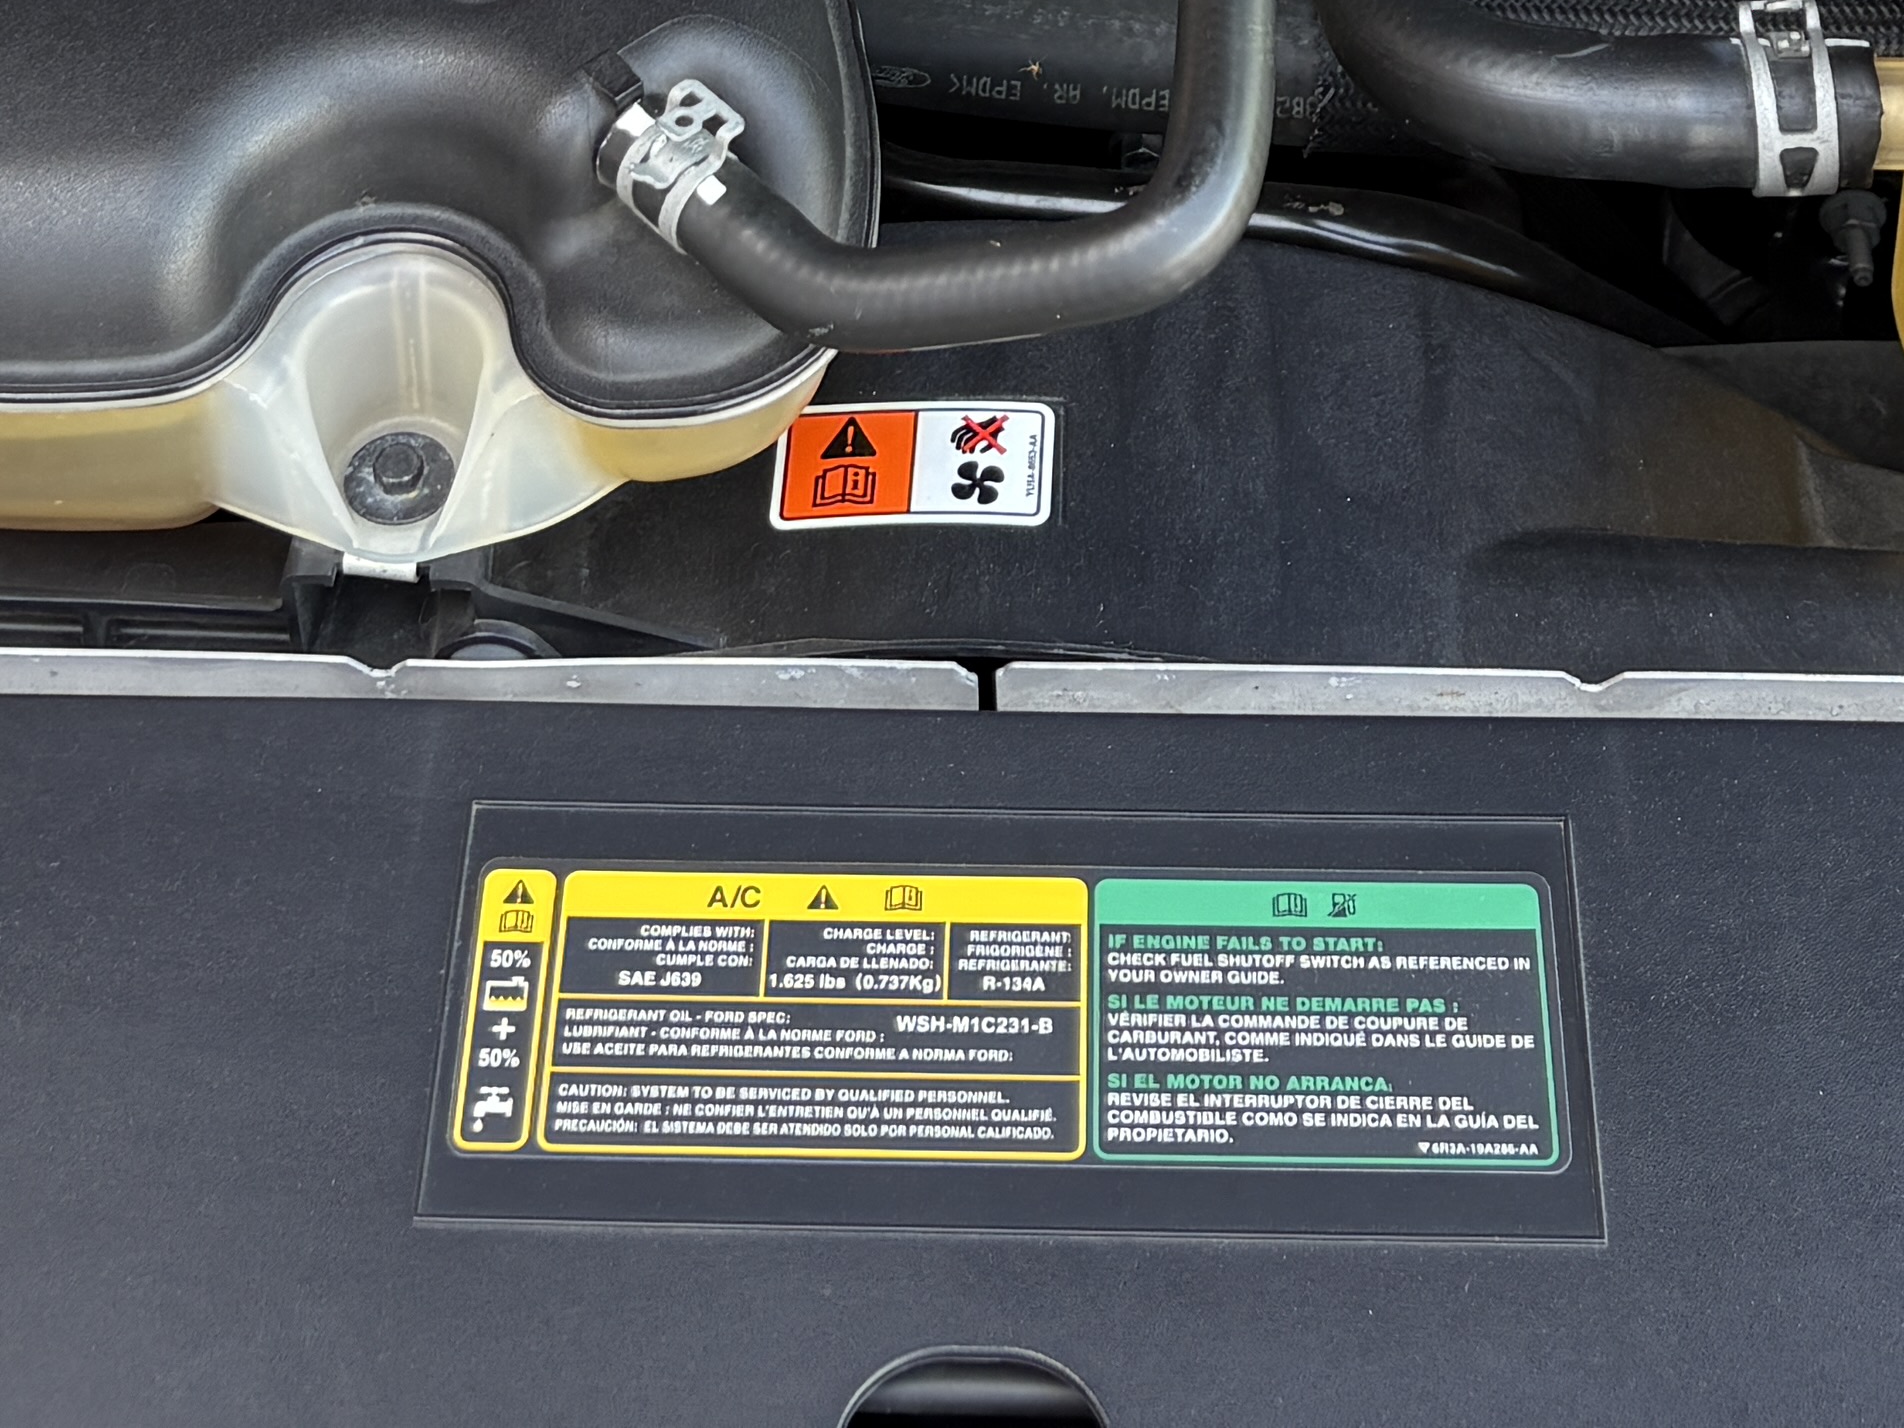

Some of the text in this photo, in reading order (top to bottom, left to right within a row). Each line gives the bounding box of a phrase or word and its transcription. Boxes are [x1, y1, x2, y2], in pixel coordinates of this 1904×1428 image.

[707, 885, 761, 909] A/C
[1108, 934, 1384, 952] IF ENGINE FAILS TO START:
[490, 949, 531, 969] 50%
[1107, 952, 1532, 970] CHECK FUEL SHUTOFF SWITCH AS REFERENCED IN
[618, 970, 702, 987] SAE J639
[769, 973, 942, 992] 1.625 lbs (0.737Kg)
[982, 976, 1046, 992] R-134A
[1107, 969, 1284, 985] YOUR OWNER GUIDE.
[1107, 994, 1446, 1013] SI LE MOTEUR NE DEMARRE PAS
[895, 1015, 1053, 1034] WSH-M1C231-B
[1107, 1010, 1468, 1031] VÉRIFIER LA COMMANDE DE COUPURE DE
[1107, 1030, 1535, 1049] CARBURANT, COMME INDIQUÉ DANS LE GUIDE DE
[478, 1047, 520, 1068] 50%
[1107, 1046, 1270, 1062] L'AUTOMOBILISTE.
[1107, 1073, 1128, 1089] SI
[1134, 1074, 1160, 1089] EL
[1166, 1074, 1243, 1090] MOTOR
[1249, 1075, 1280, 1090] NO
[1107, 1092, 1474, 1111] REVISE EL INTERRUPTOR DE CIERRE DEL
[1107, 1111, 1540, 1129] COMBUSTIBLE COMO SE INDICA EN LA GUÍA DEL
[1107, 1128, 1234, 1144] PROPIETARIO.
